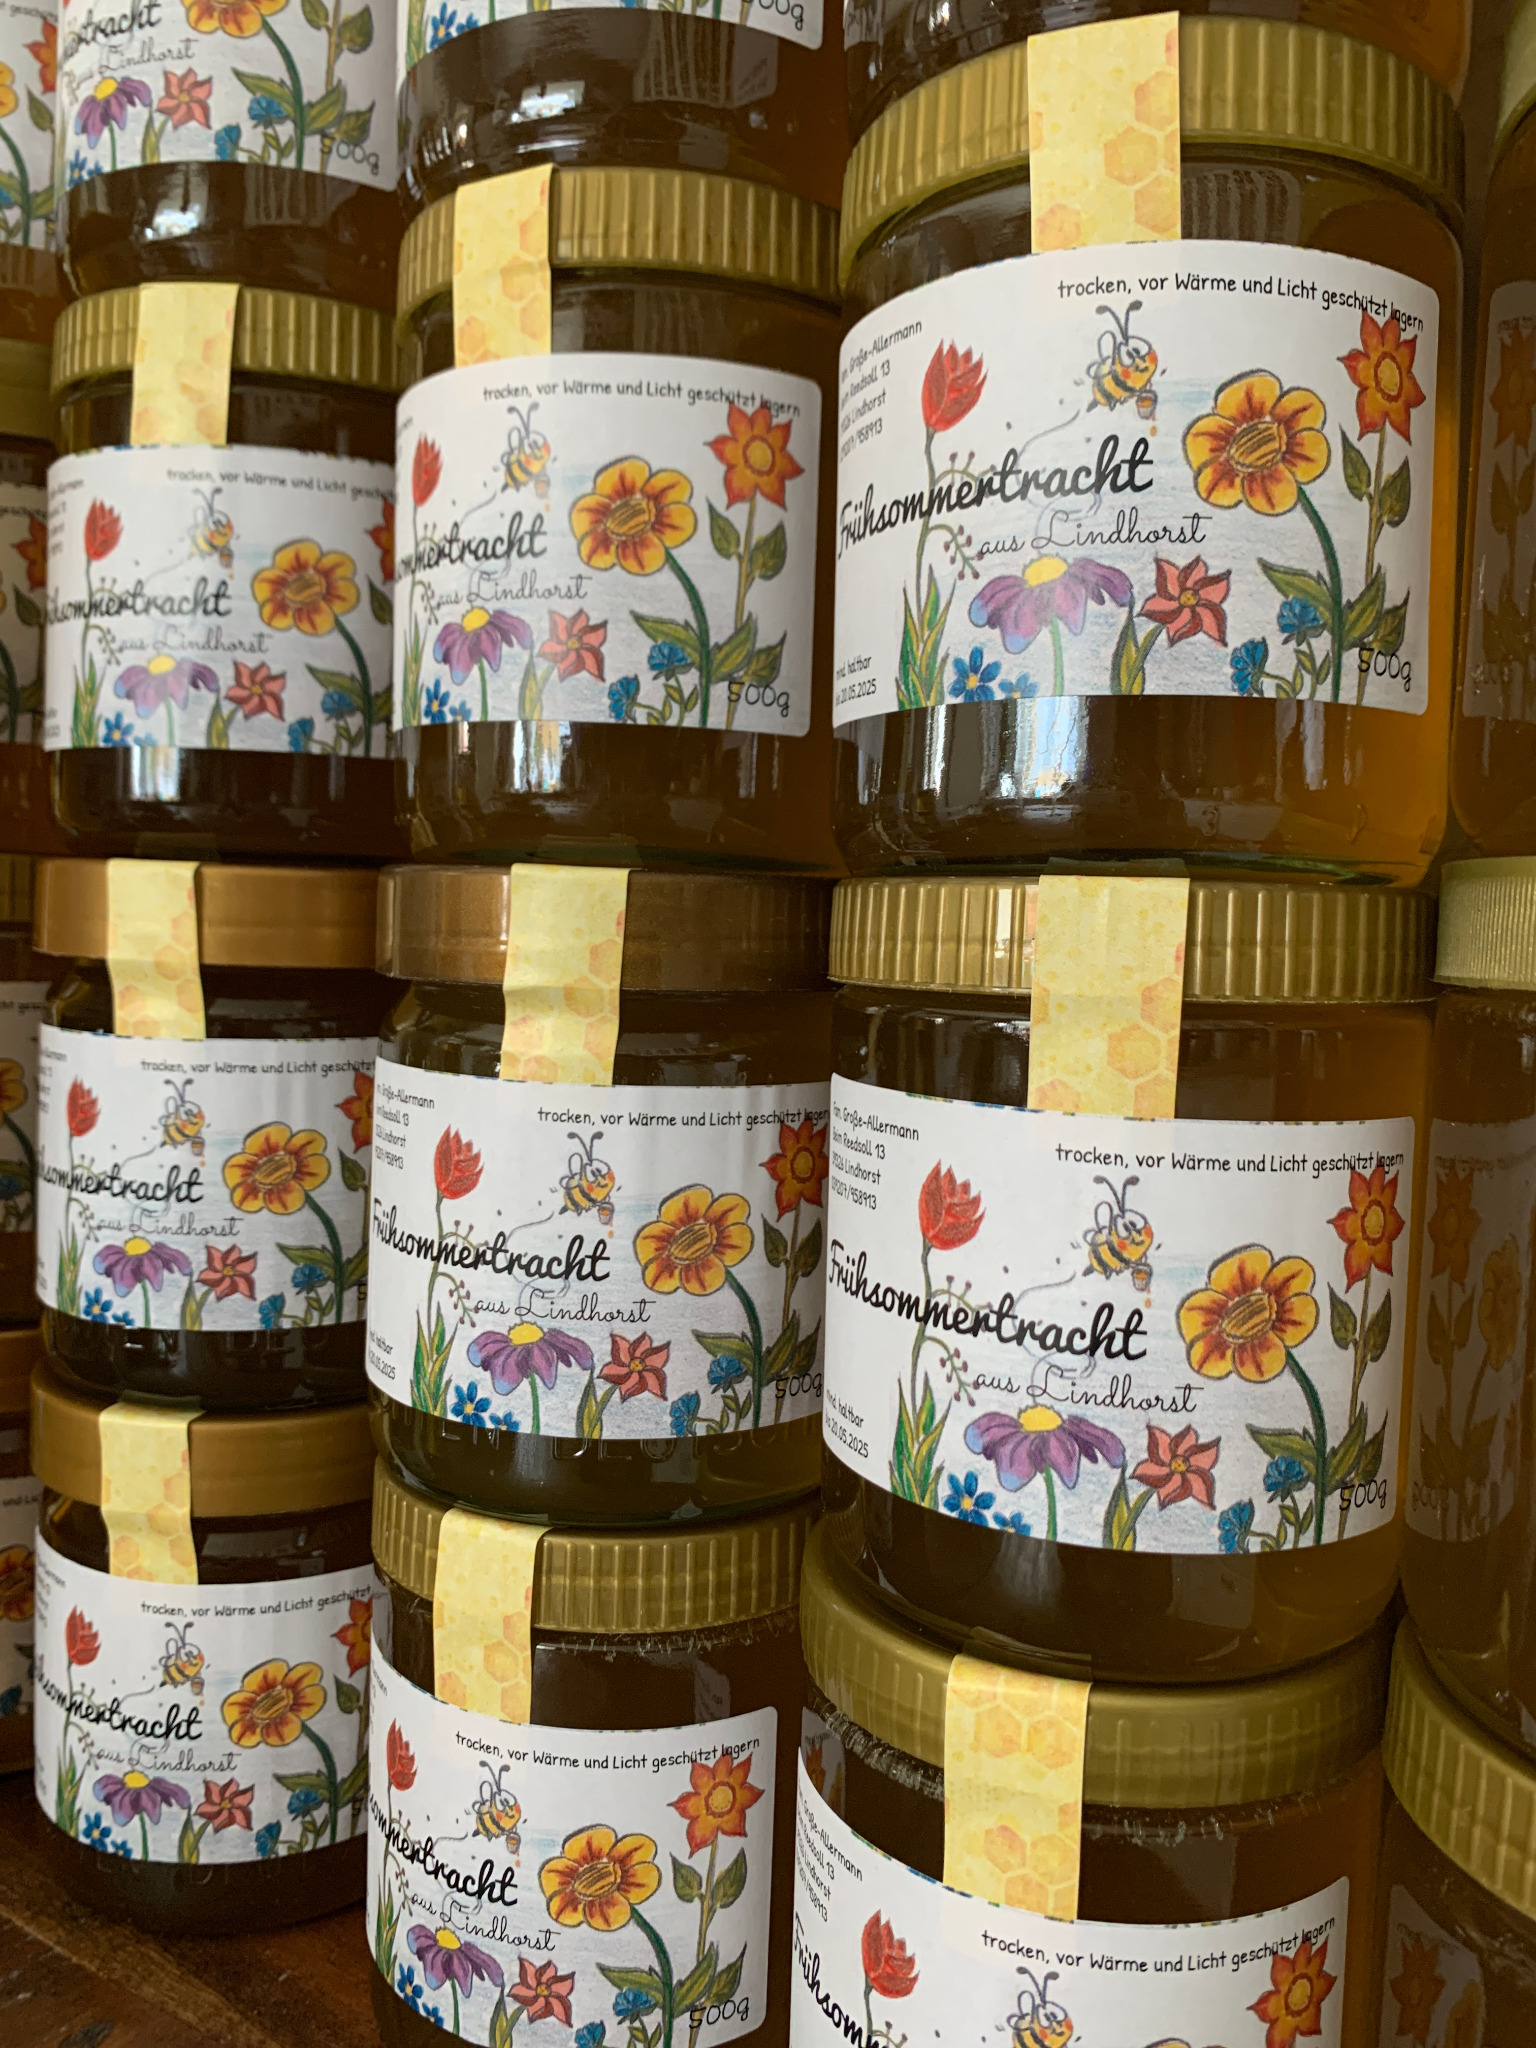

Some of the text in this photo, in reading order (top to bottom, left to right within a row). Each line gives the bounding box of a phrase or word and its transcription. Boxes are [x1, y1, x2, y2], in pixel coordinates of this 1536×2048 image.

[1057, 272, 1424, 333] trocken, vor Wärme und Licht geschützt lagern
[880, 358, 891, 379] 13
[483, 383, 532, 402] trocken,
[536, 382, 559, 396] vor
[562, 379, 613, 396] Wärme
[616, 381, 643, 397] und
[646, 382, 683, 399] Licht
[687, 385, 756, 410] geschützt
[219, 471, 241, 483] vor
[243, 471, 288, 488] Wärme
[291, 476, 315, 491] und
[317, 480, 348, 495] Licht
[837, 433, 1154, 560] Frühsommertracht
[979, 506, 1213, 556] aus Lindhorst
[467, 568, 593, 604] Lindhorst
[153, 624, 274, 654] Lindhorst
[1357, 646, 1412, 692] 500g
[727, 680, 790, 718] 500g
[140, 1059, 187, 1075] trocken,
[191, 1063, 212, 1074] vor
[214, 1061, 258, 1075] Wärme
[261, 1061, 285, 1075] und
[287, 1060, 318, 1074] Licht
[402, 1112, 410, 1127] 13
[537, 1107, 595, 1127] trocken,
[600, 1113, 624, 1126] vor
[628, 1112, 677, 1127] Wärme
[682, 1112, 706, 1127] und
[709, 1111, 743, 1127] Licht
[746, 1109, 803, 1132] geschützt
[843, 1107, 919, 1142] Große-Allermann
[843, 1132, 872, 1157] Reedsoll
[874, 1143, 886, 1160] 13
[1054, 1143, 1405, 1180] trocken, vor Wärme und Licht geschützt lagern
[845, 1158, 881, 1186] Lindhorst
[129, 1208, 244, 1238] Lindhorst
[372, 1197, 611, 1282] Frühsommertracht
[477, 1288, 657, 1323] aus Lindhorst
[828, 1239, 1148, 1360] Frühsommertracht
[775, 1372, 823, 1398] 500g
[975, 1364, 1205, 1413] aus Lindhorst
[838, 1397, 865, 1428] haltbar
[1339, 1478, 1387, 1512] 500g
[140, 1600, 188, 1618] trocken,
[191, 1606, 211, 1617] vor
[214, 1605, 257, 1618] Wärme
[260, 1600, 282, 1615] und
[284, 1596, 315, 1613] Licht
[128, 1743, 242, 1772] Lindhorst
[455, 1730, 761, 1773] trocken, vor Wärme und Licht geschützt lagern
[805, 1853, 831, 1901] Lindhorst
[826, 1861, 835, 1880] 13
[412, 1893, 562, 1952] aus Lindhorst
[981, 1916, 1336, 1974] trocken, vor Wärme und Licht geschützt lagern
[689, 1997, 750, 2030] 500g
